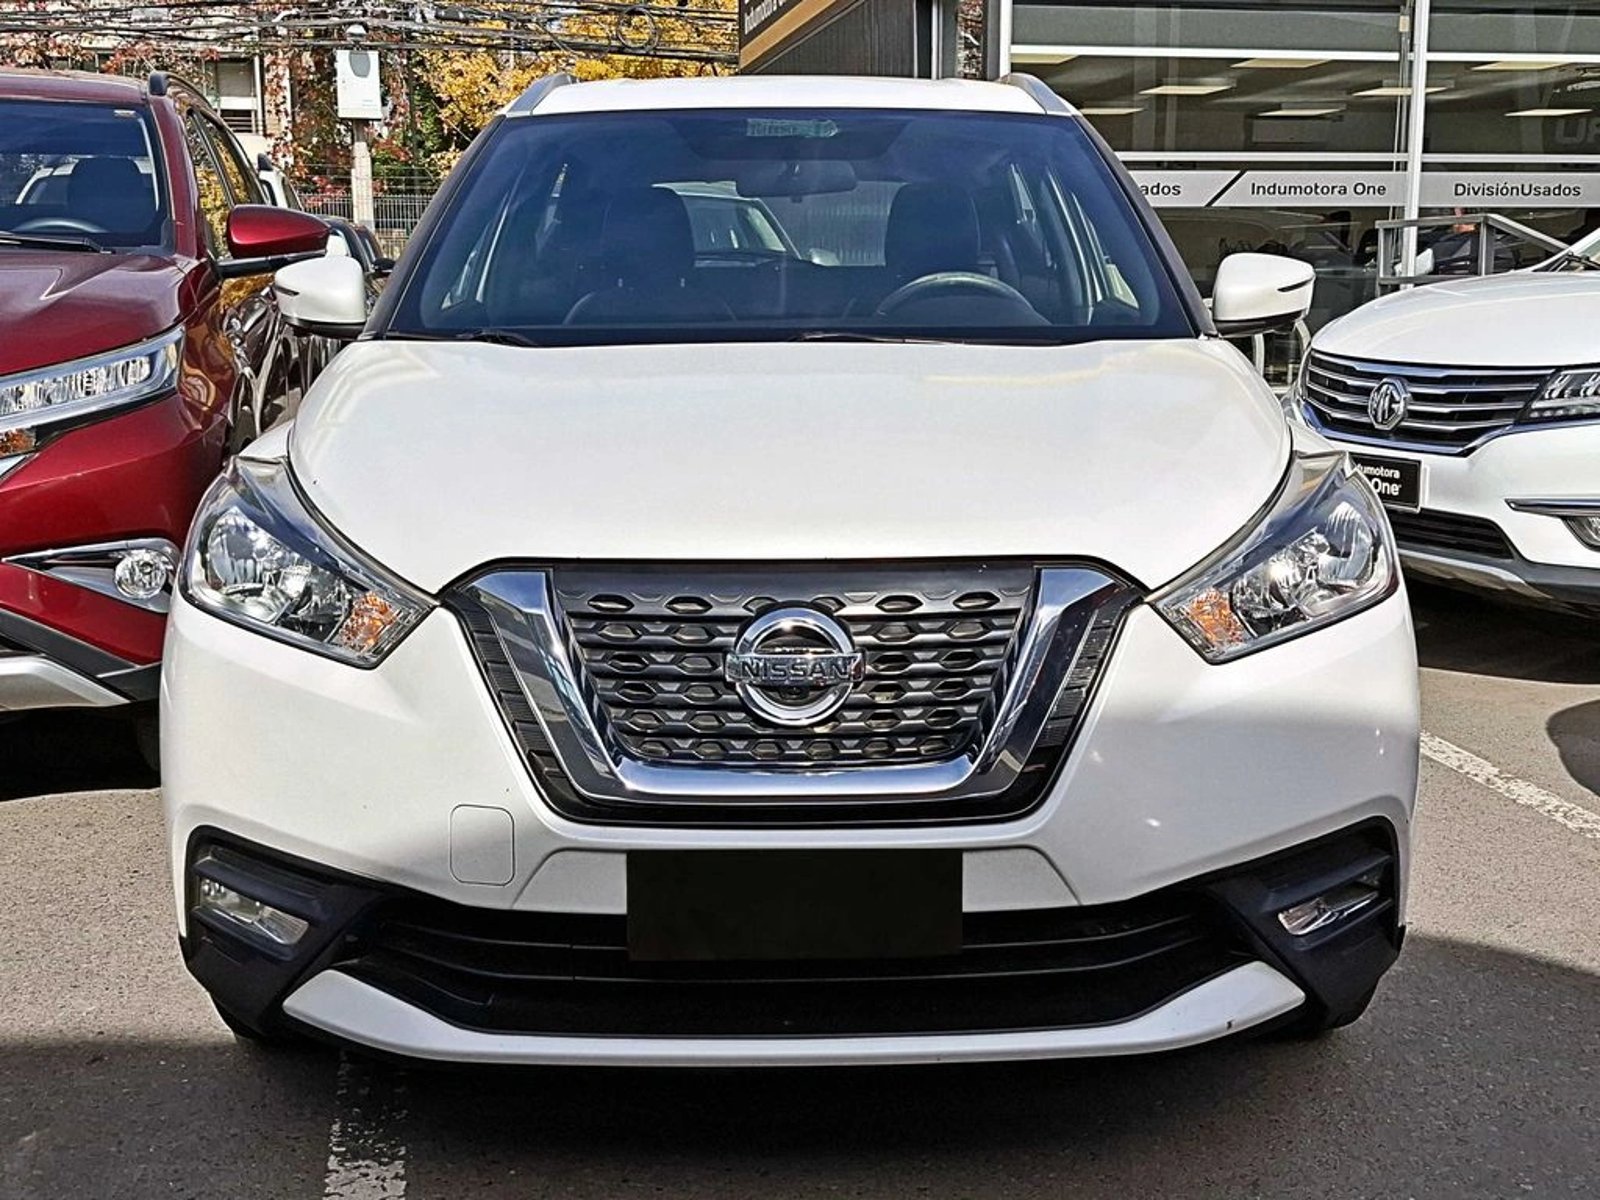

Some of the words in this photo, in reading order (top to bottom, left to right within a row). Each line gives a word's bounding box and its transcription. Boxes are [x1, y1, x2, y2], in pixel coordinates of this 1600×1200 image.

[1251, 182, 1347, 195] Indumotora
[1353, 182, 1387, 195] One
[1454, 181, 1581, 196] DivisiónUsados
[741, 659, 850, 678] NISSAN
